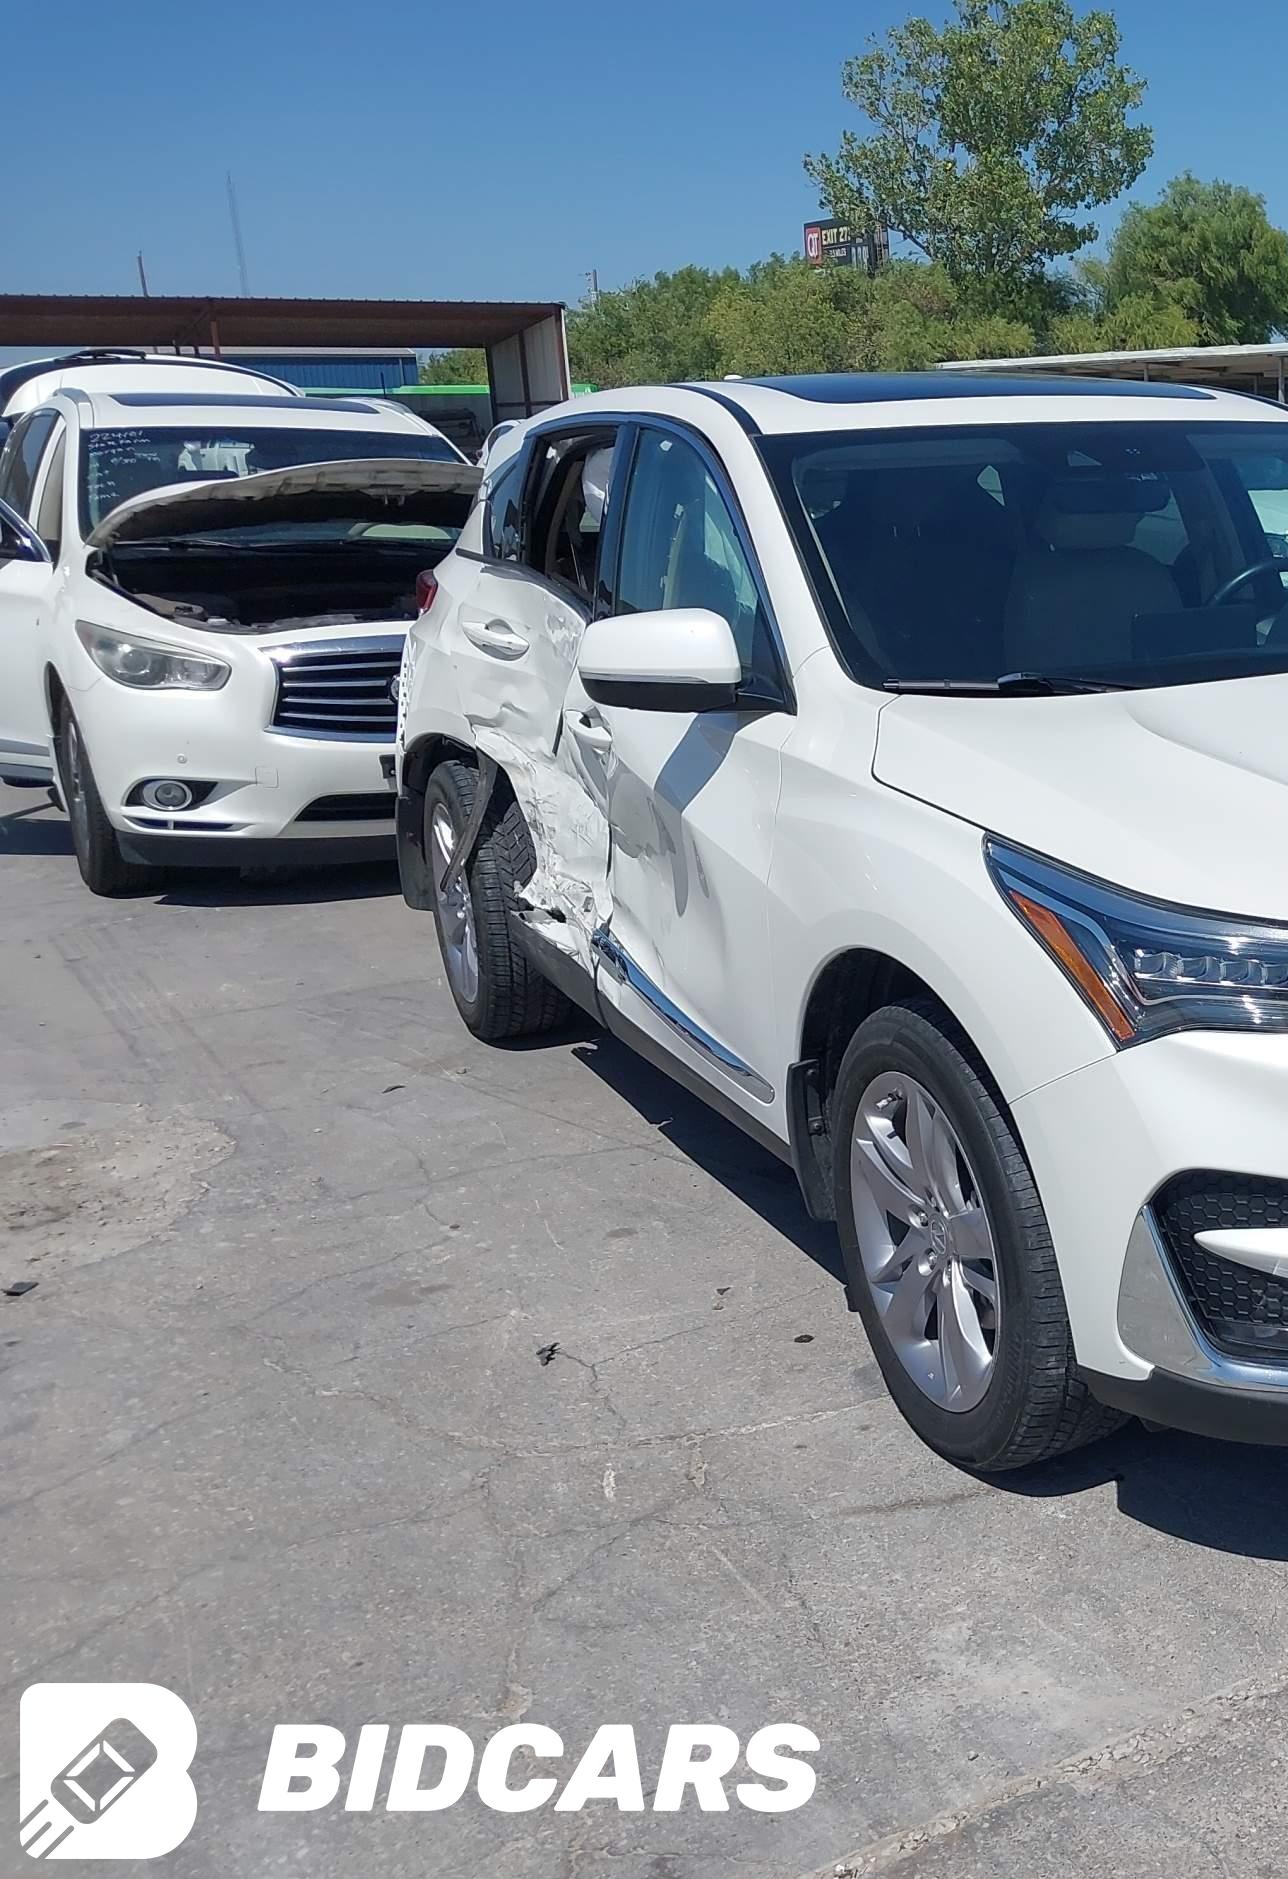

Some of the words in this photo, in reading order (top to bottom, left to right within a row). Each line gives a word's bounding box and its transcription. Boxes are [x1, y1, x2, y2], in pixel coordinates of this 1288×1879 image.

[807, 232, 819, 257] QT
[821, 228, 838, 246] EXIT
[839, 226, 851, 243] 27
